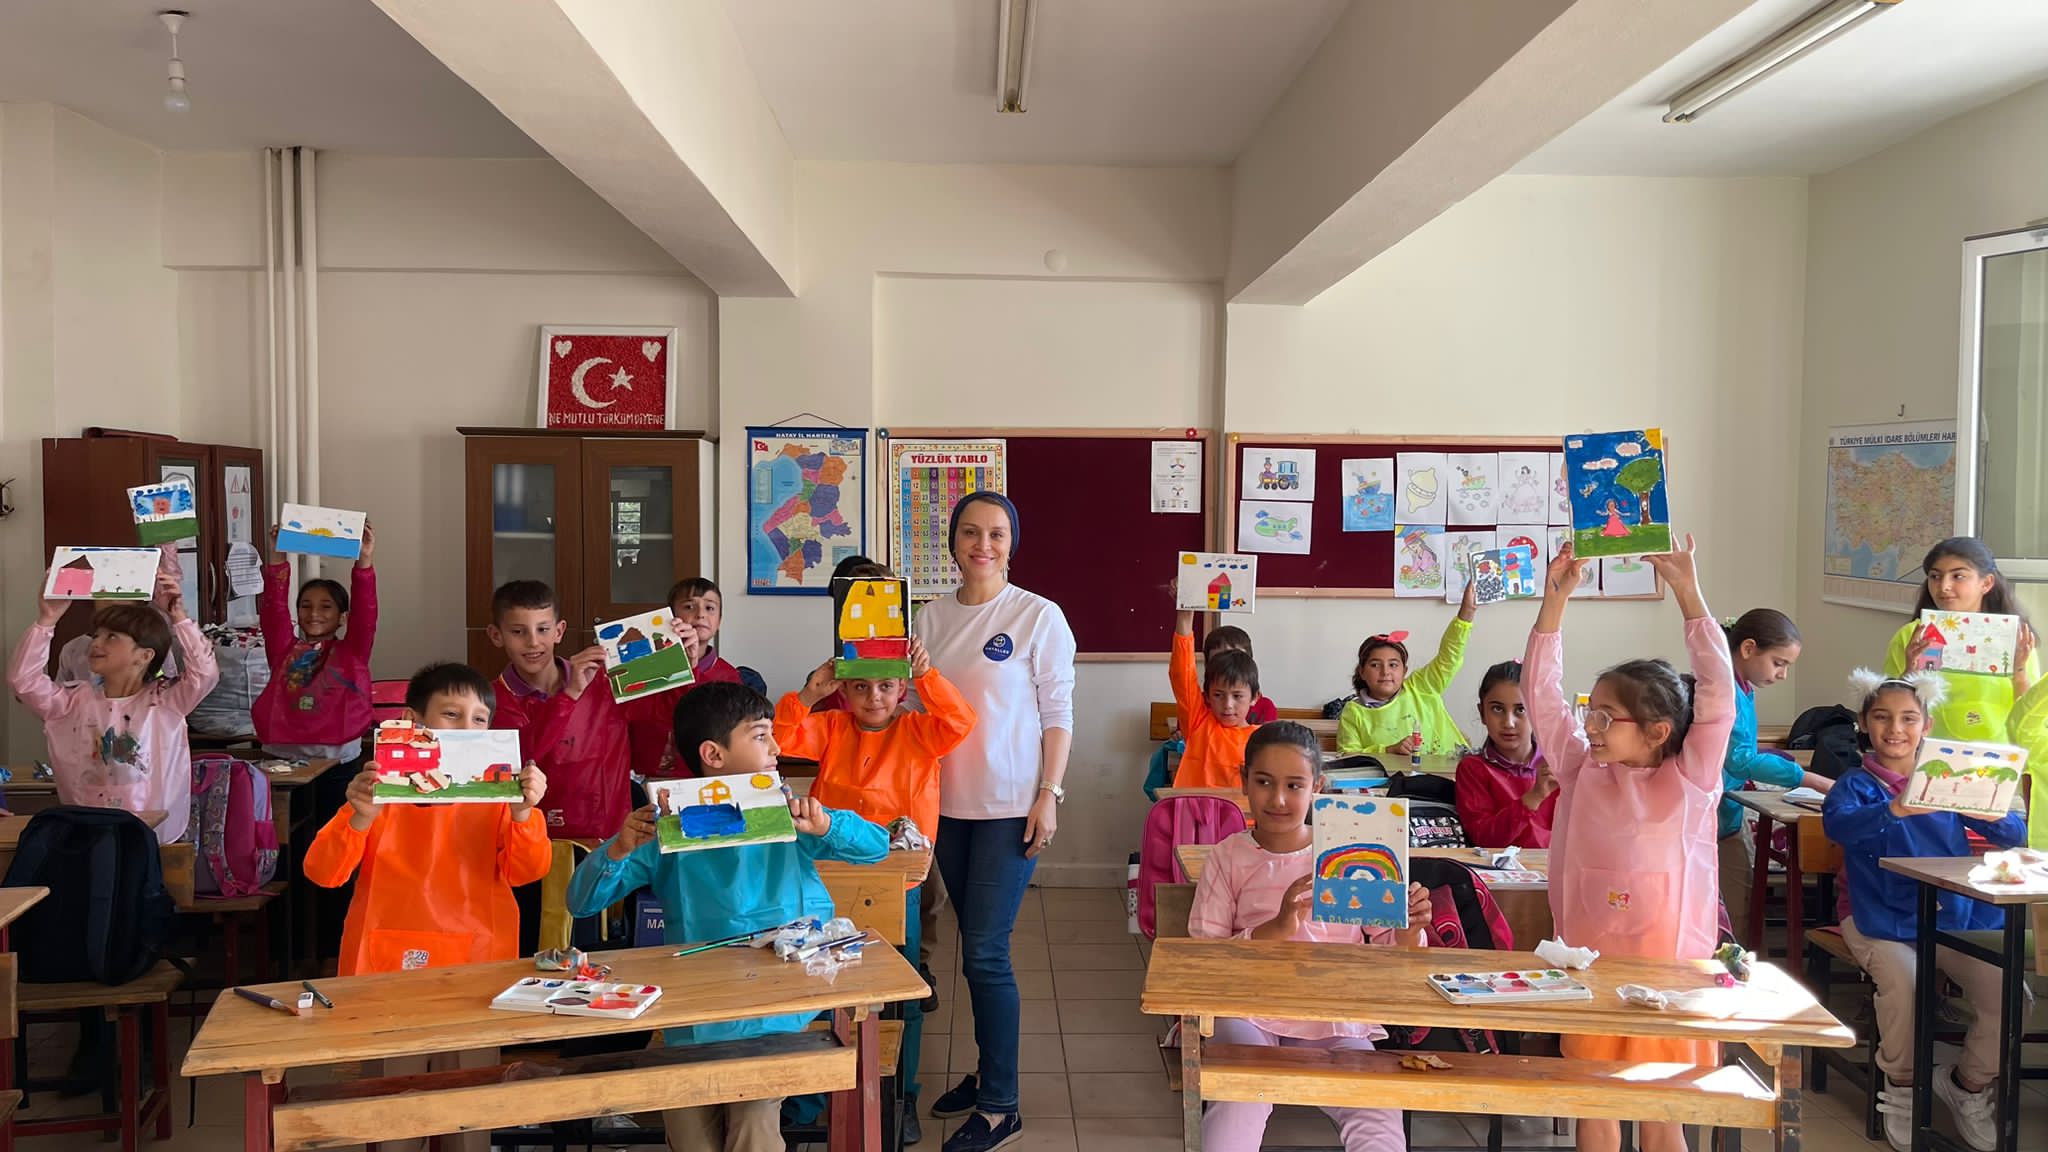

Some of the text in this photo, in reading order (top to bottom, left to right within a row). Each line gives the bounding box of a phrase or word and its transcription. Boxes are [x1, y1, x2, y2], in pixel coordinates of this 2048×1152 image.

[549, 413, 561, 425] NE
[563, 413, 595, 425] MUTLU
[1840, 435, 1863, 445] TÜRKİYE
[911, 453, 988, 464] YÜZLÜK TABLO
[647, 919, 665, 929] MA
